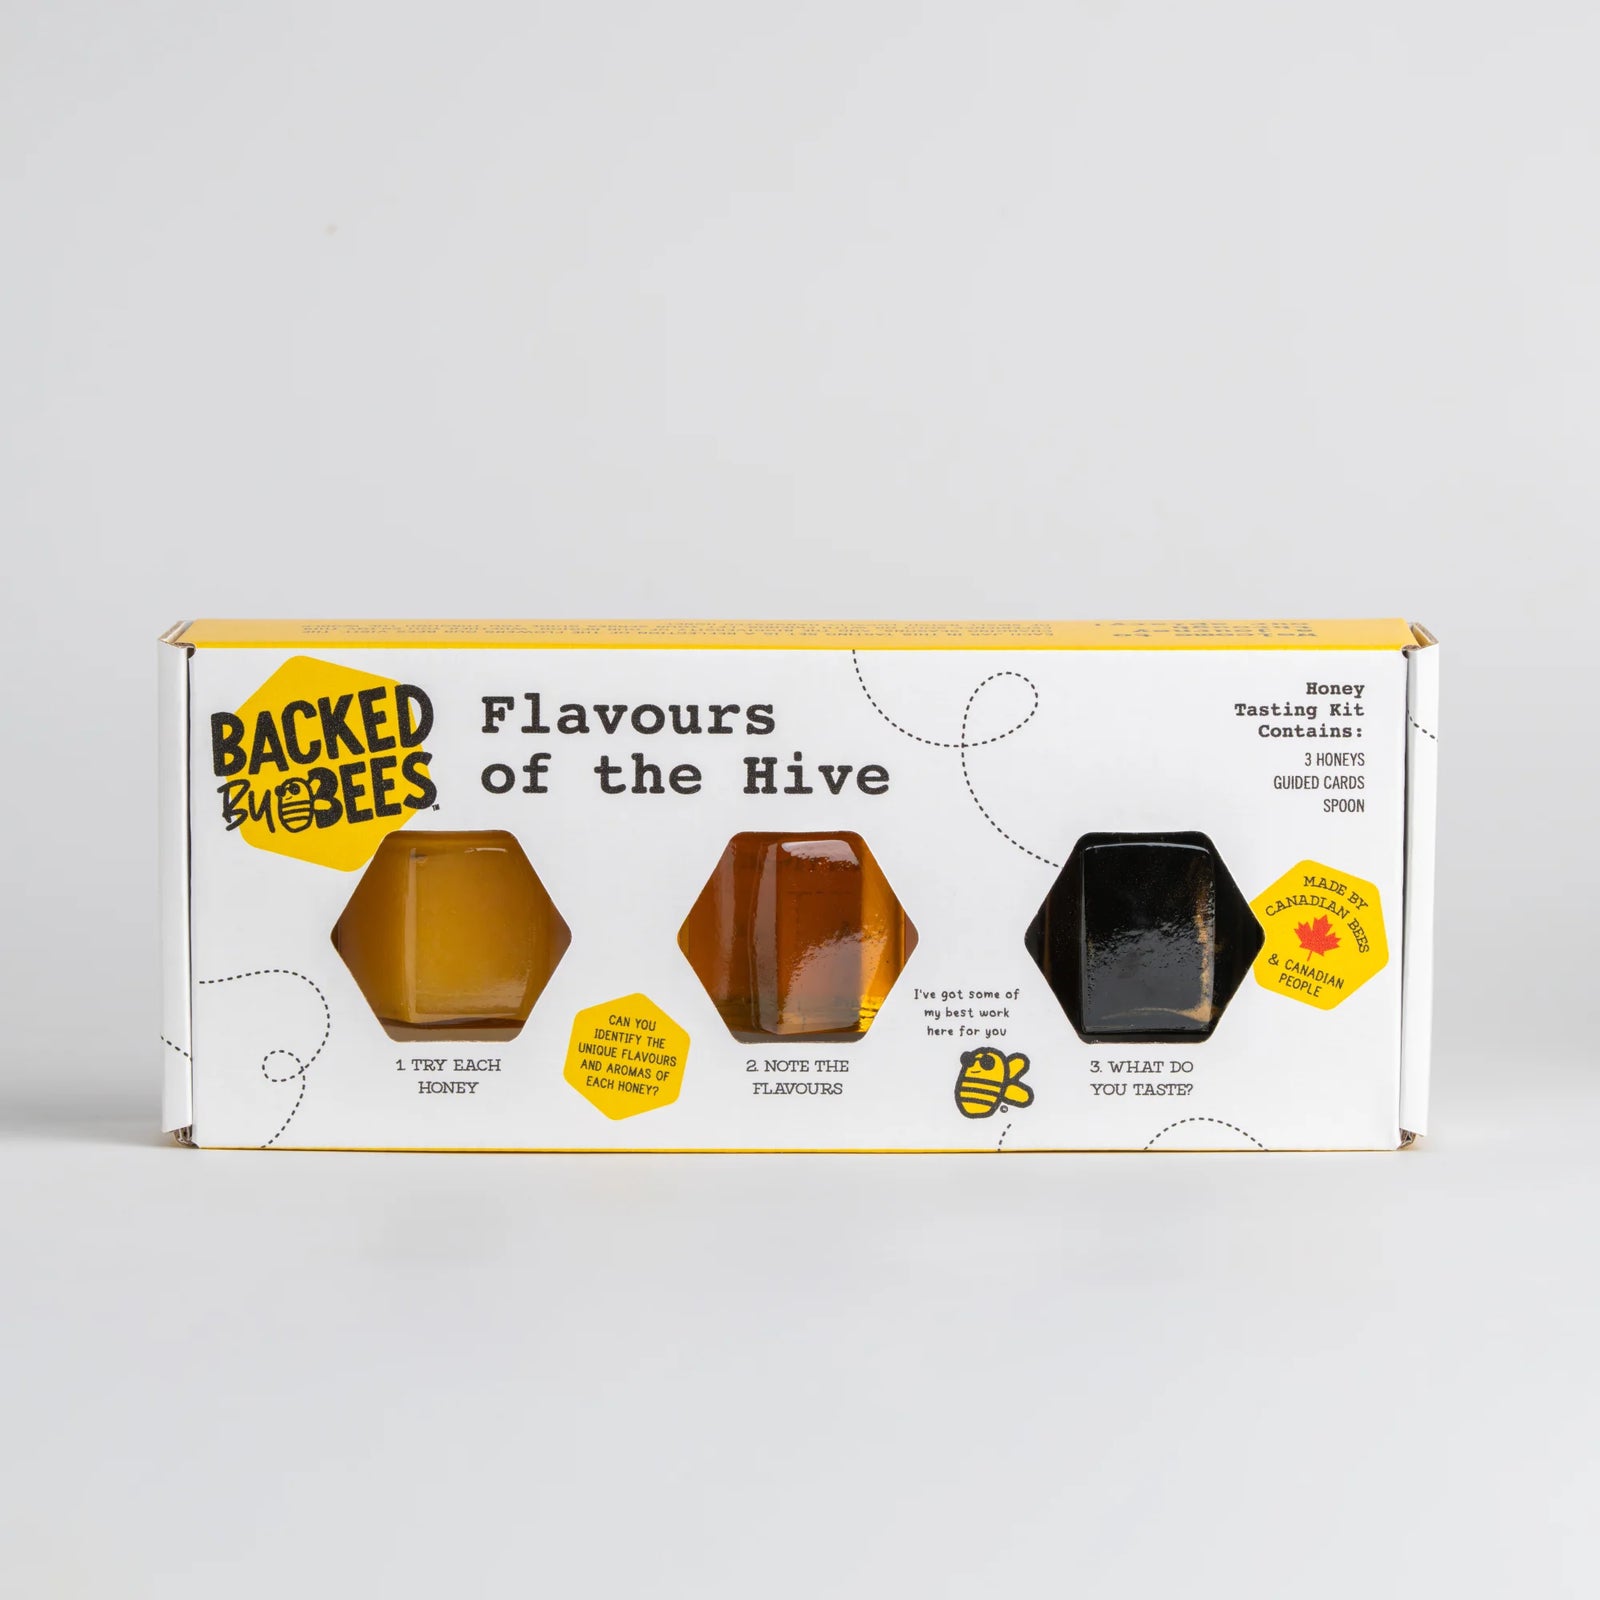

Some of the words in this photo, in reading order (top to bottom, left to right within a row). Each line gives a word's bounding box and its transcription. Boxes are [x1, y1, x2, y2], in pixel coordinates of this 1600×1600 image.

[1305, 681, 1366, 699] Honey
[480, 692, 776, 736] Flavours
[1234, 702, 1318, 720] Tasting
[1329, 702, 1365, 717] Kit
[209, 683, 435, 778] BACKED
[1258, 724, 1363, 739] Contains:
[1304, 752, 1312, 767] 3
[1316, 752, 1365, 767] HONEYS
[480, 751, 552, 795] of
[593, 751, 703, 795] the
[742, 750, 891, 796] Hive
[309, 751, 439, 830] BEES
[1273, 775, 1320, 790] GUIDED
[1323, 775, 1365, 790] CARDS
[1323, 798, 1365, 813] SPOON
[1303, 875, 1348, 896] MADE
[1347, 891, 1369, 910] BY
[1265, 894, 1350, 920] CANADIAN
[1347, 918, 1370, 954] BEES
[1267, 953, 1279, 966] &
[1284, 958, 1345, 990] CANADIAN
[1278, 972, 1322, 998] PEOPLE
[914, 988, 936, 1000] I've
[941, 989, 964, 1001] got
[969, 990, 1000, 999] some
[1005, 988, 1020, 1000] of
[924, 1008, 941, 1020] my
[945, 1007, 974, 1018] best
[979, 1008, 1010, 1018] work
[608, 1014, 631, 1027] CAN
[635, 1018, 657, 1032] YOU
[927, 1026, 954, 1036] here
[959, 1025, 980, 1037] for
[985, 1028, 1007, 1039] you
[594, 1028, 642, 1045] IDENTIFY
[646, 1036, 667, 1049] THE
[578, 1042, 618, 1058] UNIQUE
[621, 1048, 677, 1067] FLAVOURS
[411, 1058, 448, 1072] TRY
[453, 1058, 502, 1072] EACH
[580, 1059, 602, 1072] AND
[606, 1063, 652, 1079] AROMAS
[655, 1070, 670, 1082] OF
[764, 1060, 809, 1072] NOTE
[814, 1060, 850, 1072] THE
[1089, 1060, 1102, 1073] 3.
[1107, 1060, 1165, 1074] WHAT
[1169, 1060, 1194, 1074] DO
[418, 1081, 480, 1094] HONEY
[586, 1075, 614, 1089] EACH
[617, 1081, 660, 1097] HONEY?
[752, 1082, 843, 1095] FLAVOURS
[1090, 1083, 1128, 1096] YOU
[1132, 1083, 1194, 1096] TASTE?
